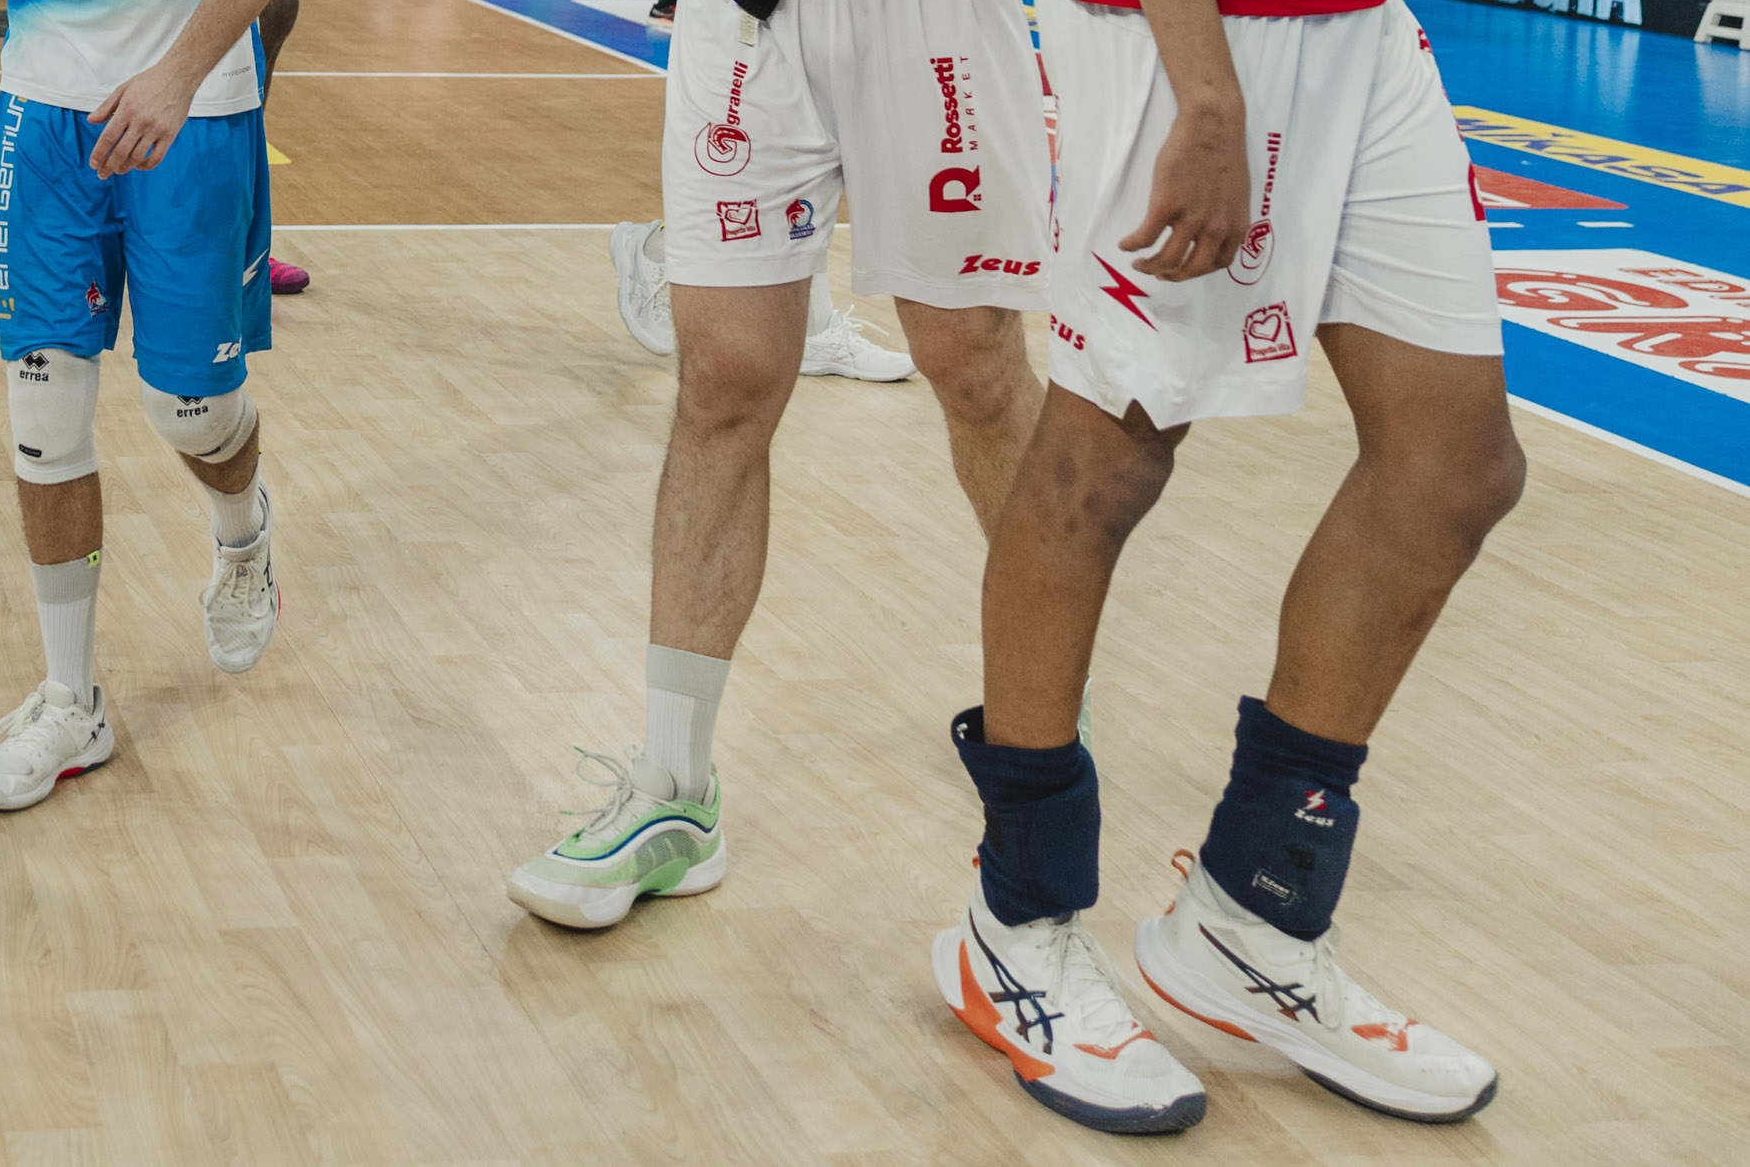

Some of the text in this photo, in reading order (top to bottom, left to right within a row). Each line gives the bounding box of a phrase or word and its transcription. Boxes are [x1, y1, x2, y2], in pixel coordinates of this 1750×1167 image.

[726, 60, 749, 127] granelli
[929, 56, 965, 154] Rossetti
[960, 55, 979, 151] MARKET
[959, 254, 1042, 276] Zeus
[1050, 313, 1086, 351] eus
[19, 369, 49, 383] errea
[176, 404, 209, 418] errea
[1294, 808, 1335, 827] Zeus
